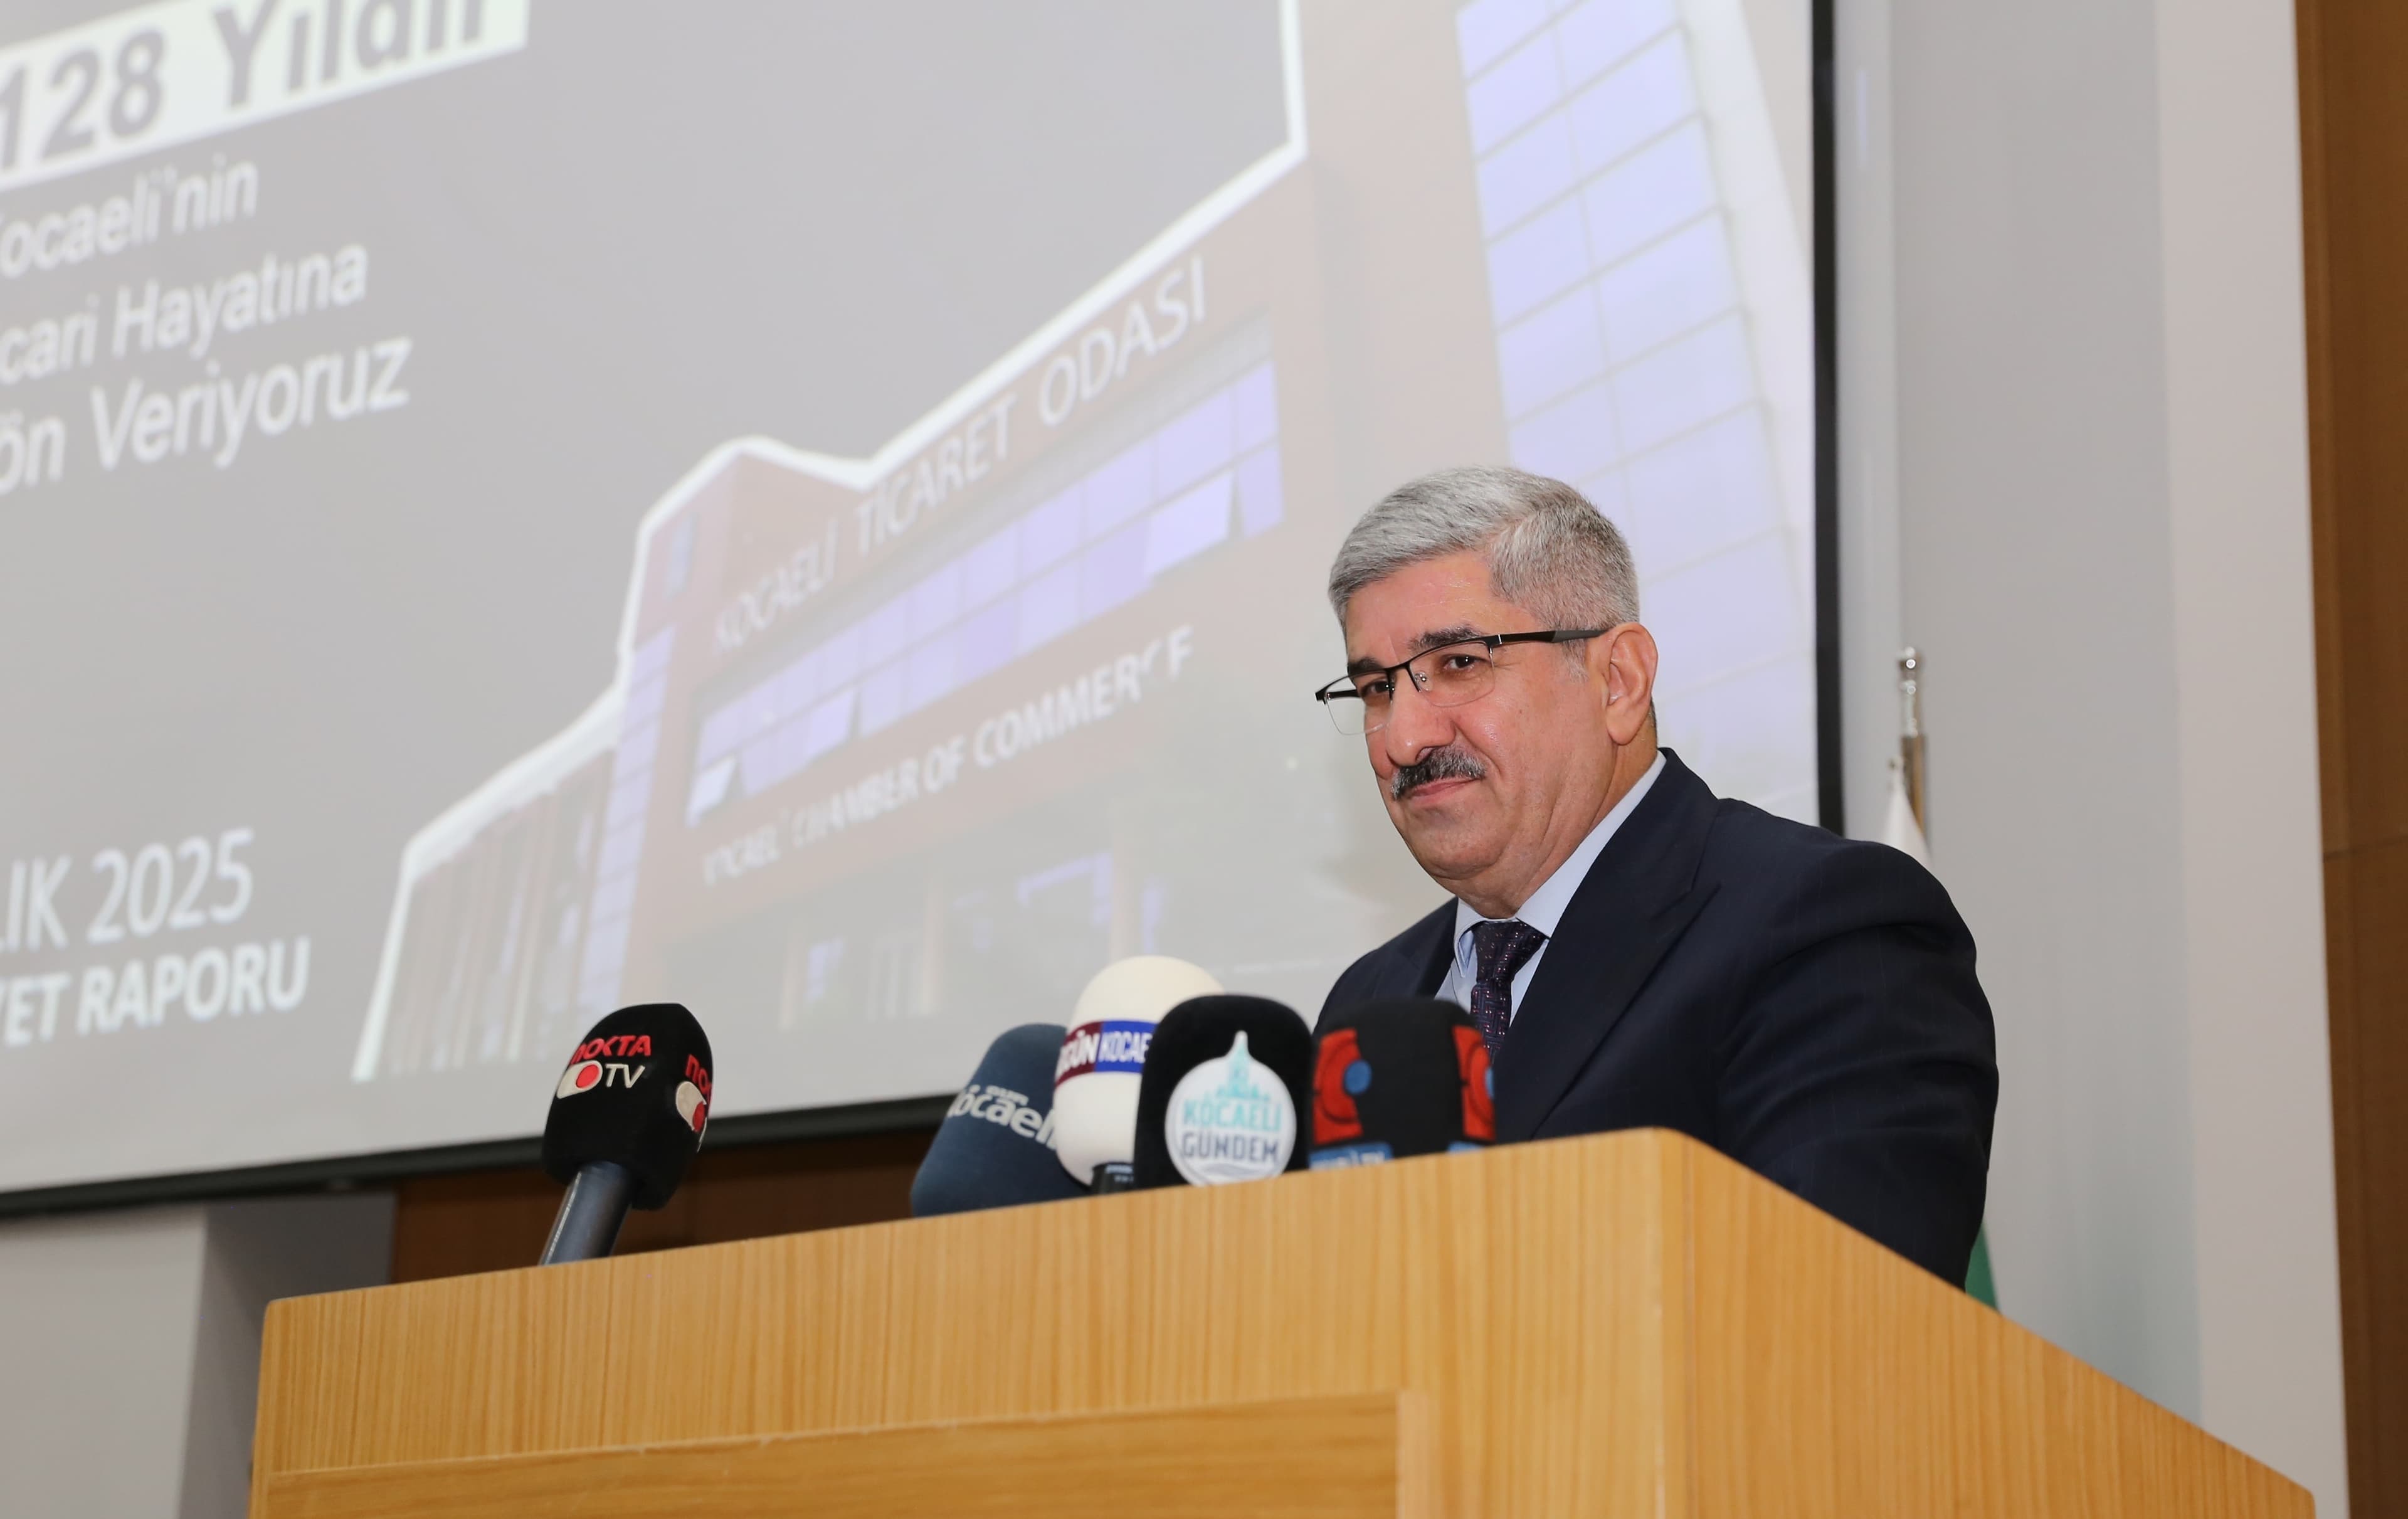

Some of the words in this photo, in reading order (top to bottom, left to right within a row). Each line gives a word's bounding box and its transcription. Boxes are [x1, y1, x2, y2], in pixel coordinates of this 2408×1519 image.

[0, 29, 166, 169] 128
[0, 152, 258, 278] ocaeli'nin
[0, 293, 98, 386] cari
[113, 245, 367, 359] Hayatına
[1037, 255, 1207, 428] ODASI
[0, 410, 66, 495] ön
[90, 337, 412, 469] Veriyoruz
[923, 735, 966, 793] OF
[0, 854, 72, 953] IK
[87, 827, 253, 945] 2025
[0, 971, 72, 1047] ET
[77, 935, 312, 1036] RAPORU
[1097, 1030, 1153, 1064] KOCAE
[605, 1063, 646, 1088] TV
